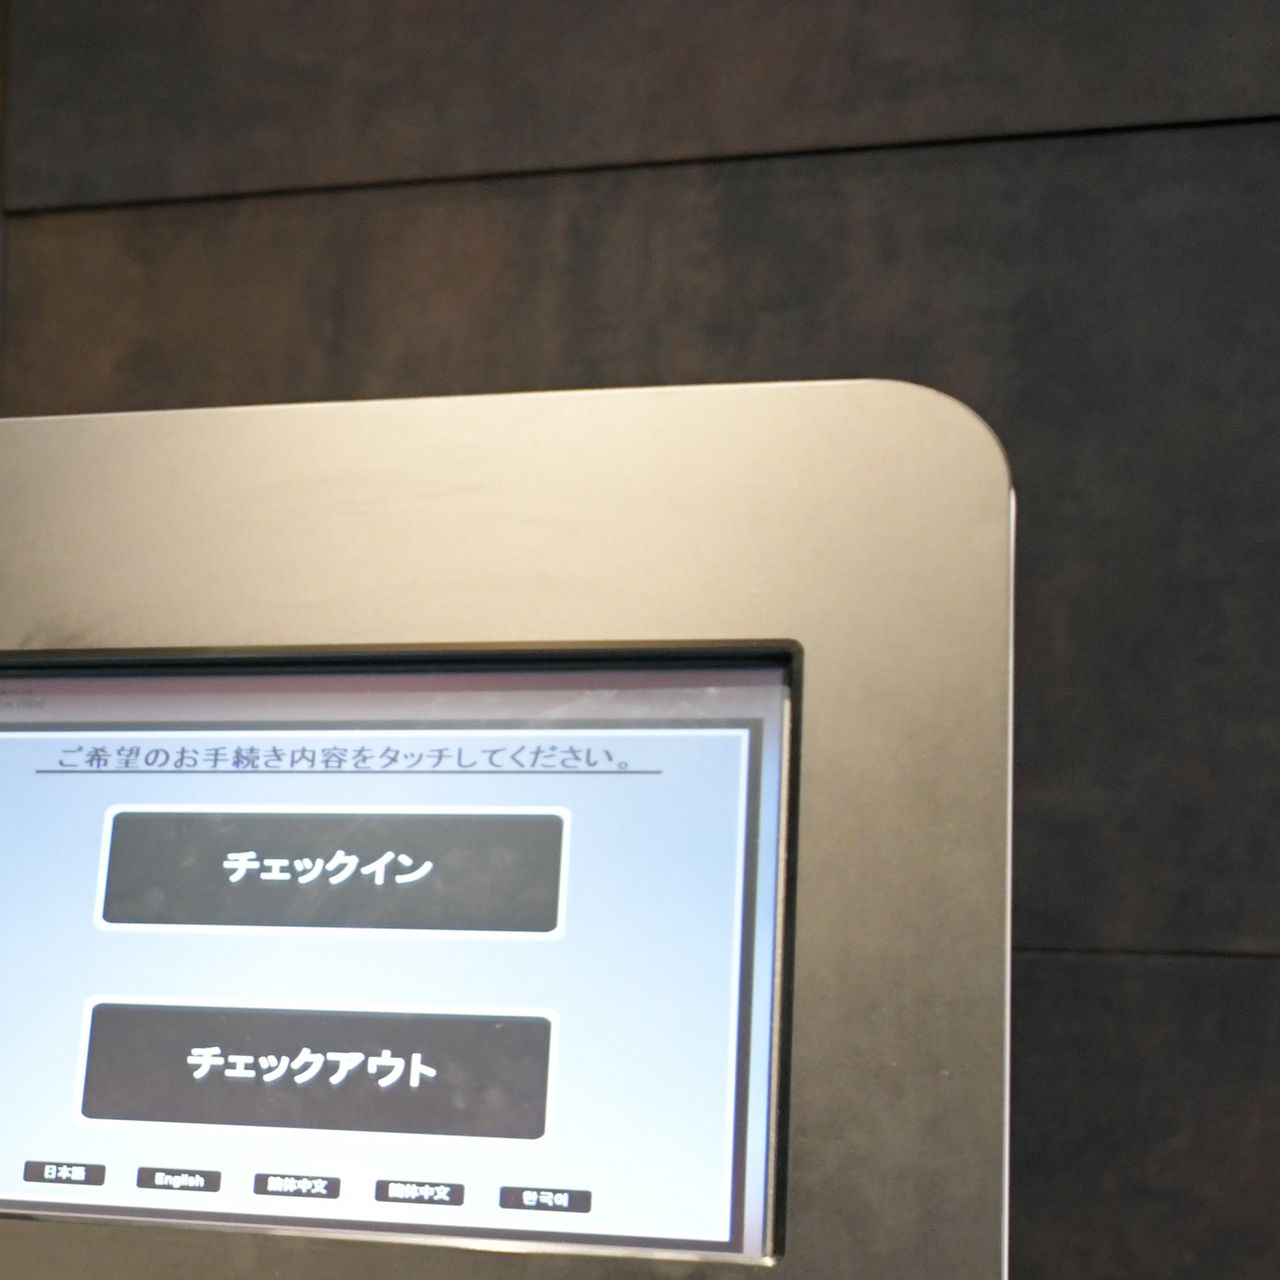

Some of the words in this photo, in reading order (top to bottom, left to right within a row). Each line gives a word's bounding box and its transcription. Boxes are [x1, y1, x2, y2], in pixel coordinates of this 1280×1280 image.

[57, 745, 629, 770] ご希望のお手続き内容をタッチしてください。
[223, 850, 433, 885] チェックイン
[187, 1046, 437, 1088] チェックアウト
[44, 1165, 87, 1181] 日本語
[155, 1172, 205, 1189] English
[522, 1190, 570, 1208] 한국어
